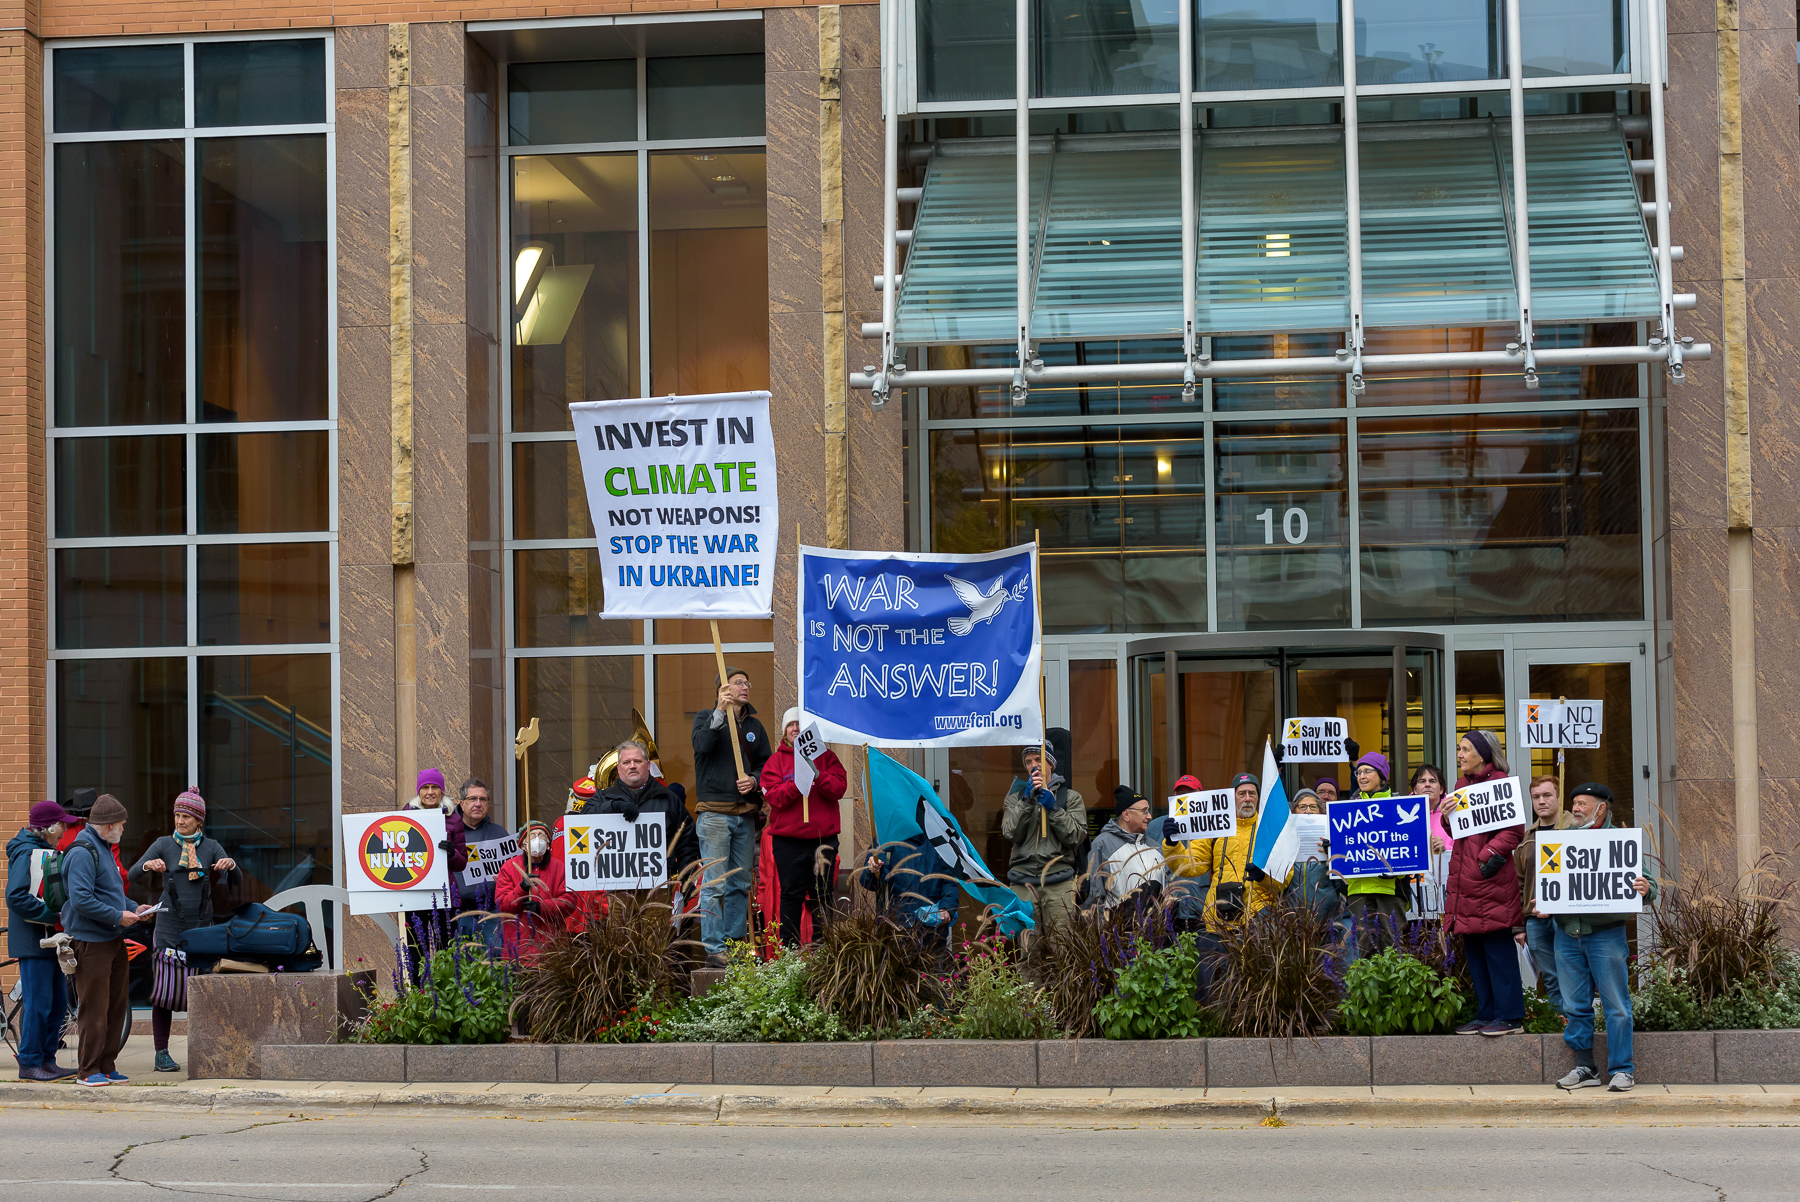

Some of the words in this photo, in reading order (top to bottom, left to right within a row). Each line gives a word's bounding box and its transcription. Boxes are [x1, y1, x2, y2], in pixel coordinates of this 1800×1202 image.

[594, 418, 708, 451] INVEST
[716, 416, 755, 445] IN
[604, 461, 757, 497] CLIMATE
[608, 508, 653, 526] NOT
[656, 505, 761, 525] WEAPONS!
[1256, 507, 1309, 544] 10
[610, 535, 663, 554] STOP
[666, 535, 699, 554] THE
[703, 534, 759, 553] WAR
[618, 565, 643, 586] IN
[650, 564, 760, 587] UKRAINE!
[823, 573, 919, 612] WAR
[810, 620, 826, 638] IS
[833, 624, 889, 652] NOT
[895, 628, 945, 646] THE
[827, 659, 999, 699] ANSWER!
[934, 711, 1023, 730] www.fcnl.org
[1567, 706, 1592, 723] NO
[797, 729, 814, 747] NO
[1302, 725, 1320, 739] Say
[1325, 722, 1341, 737] NO
[1527, 723, 1598, 744] NUKES
[1288, 744, 1298, 756] to
[1302, 740, 1342, 756] NUKES
[1189, 800, 1208, 814] Say
[1212, 793, 1229, 811] NO
[1469, 791, 1489, 806] Say
[1493, 782, 1513, 801] NO
[1190, 813, 1231, 833] NUKES
[1332, 803, 1384, 833] WAR
[1458, 816, 1469, 830] to
[1471, 802, 1516, 827] NUKES
[382, 830, 410, 850] NO
[593, 828, 628, 852] Say
[635, 823, 663, 849] NO
[1345, 835, 1355, 845] is
[1357, 830, 1388, 844] NOT
[1390, 832, 1409, 842] the
[370, 851, 425, 869] NUKES
[479, 848, 498, 860] Say
[499, 839, 517, 857] NO
[1344, 846, 1410, 862] ANSWER
[1565, 845, 1602, 872] Say
[1609, 840, 1638, 868] NO
[470, 866, 482, 878] to
[570, 858, 590, 880] to
[597, 851, 663, 879] NUKES
[1541, 877, 1561, 901] to
[1568, 871, 1638, 901] NUKES
